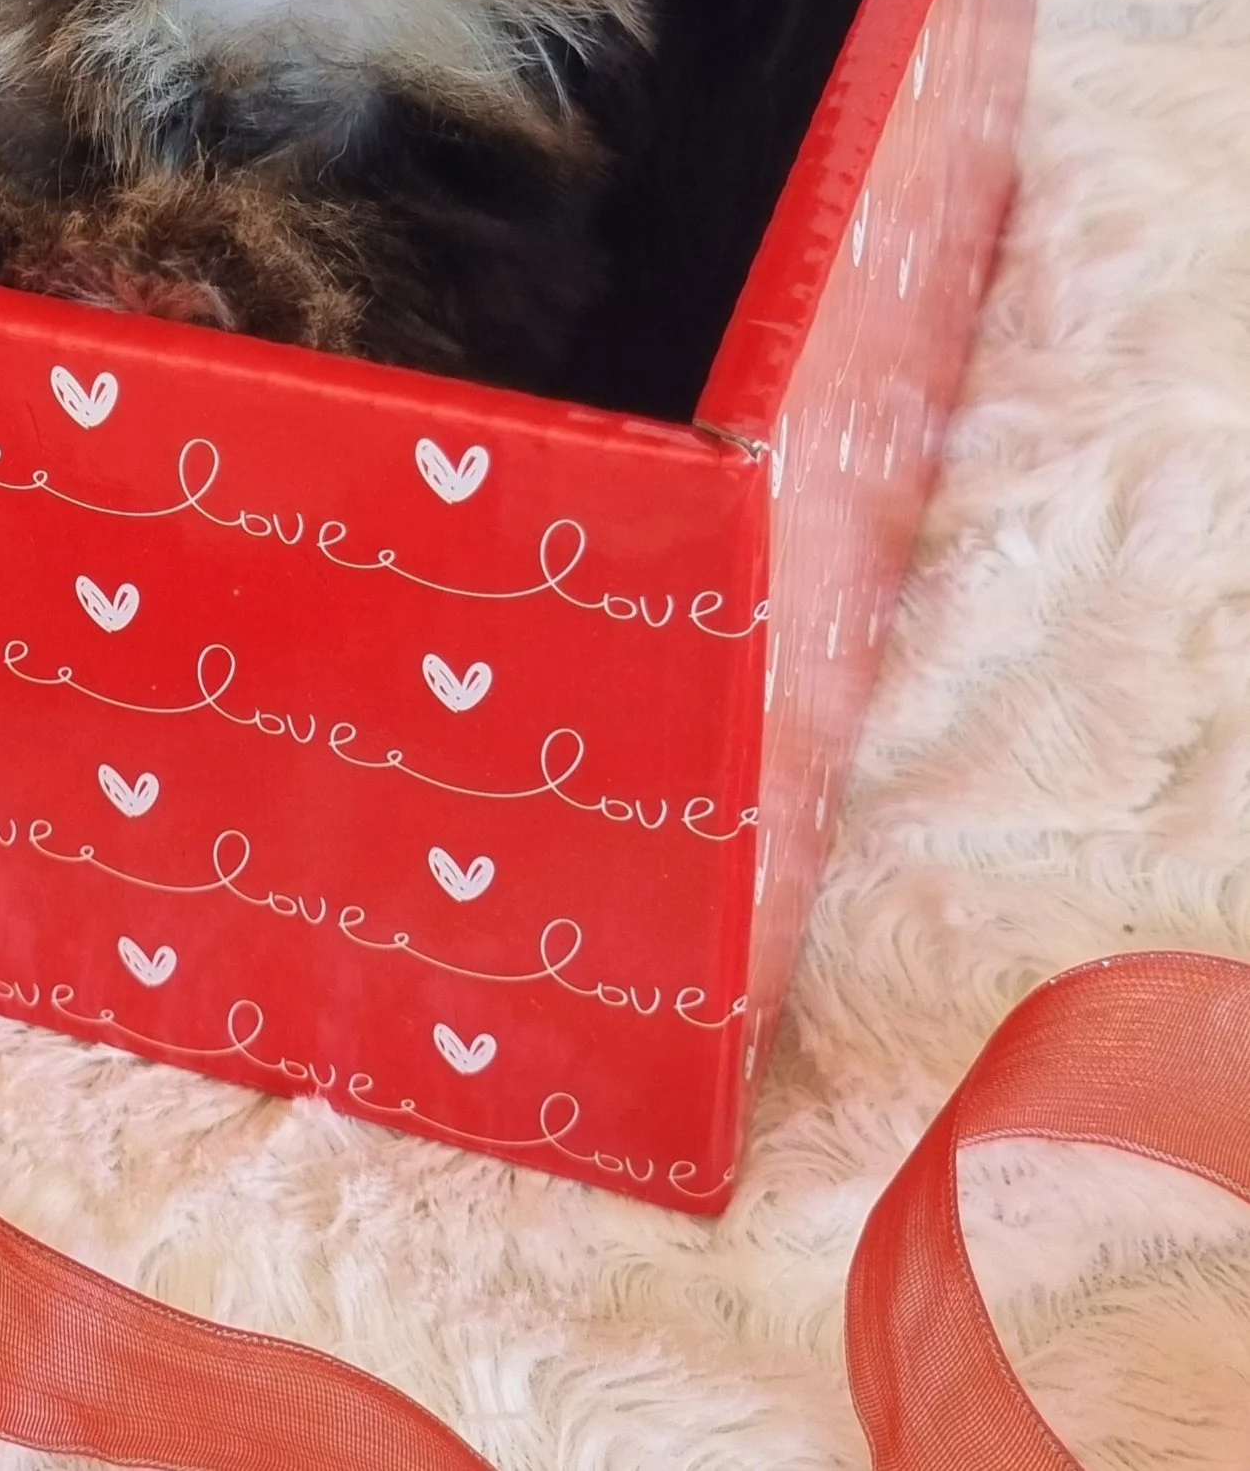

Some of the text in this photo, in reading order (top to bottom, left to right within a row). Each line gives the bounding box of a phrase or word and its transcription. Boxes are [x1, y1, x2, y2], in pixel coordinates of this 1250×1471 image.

[179, 438, 388, 568] love
[540, 519, 762, 637] love
[198, 644, 395, 767] love
[540, 728, 751, 840] love
[213, 830, 402, 948] love
[540, 919, 740, 1027] love
[228, 999, 409, 1112] love
[540, 1091, 728, 1197] love
